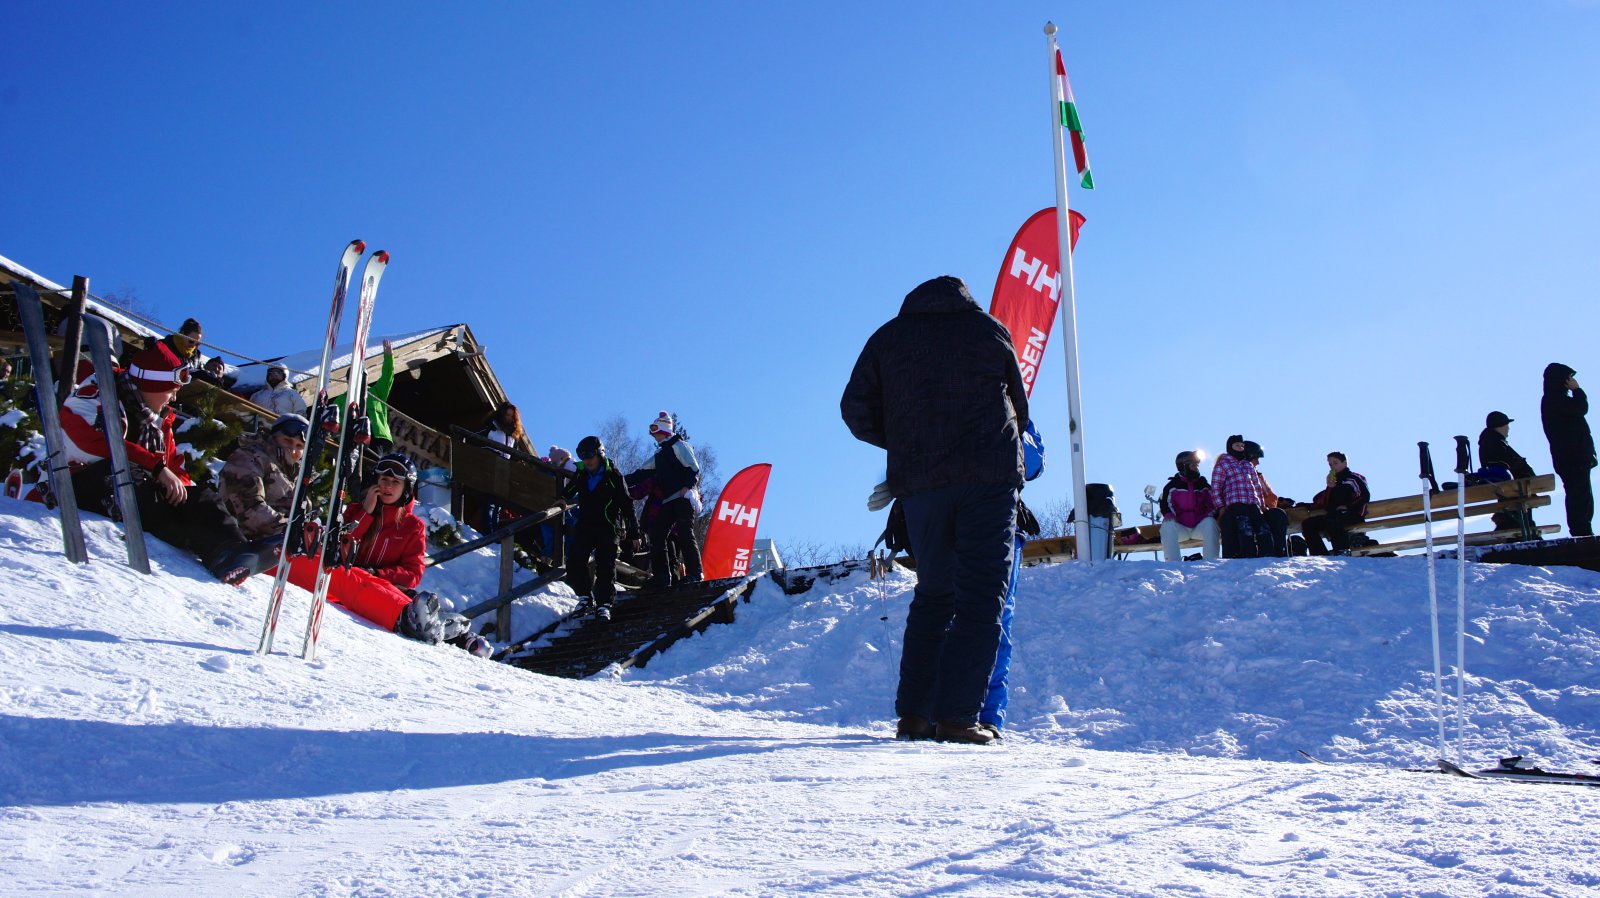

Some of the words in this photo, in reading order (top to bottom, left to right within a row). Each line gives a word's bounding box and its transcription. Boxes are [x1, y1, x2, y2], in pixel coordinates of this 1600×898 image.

[1010, 247, 1062, 302] HH
[1020, 326, 1047, 393] SEN
[718, 500, 758, 528] HH
